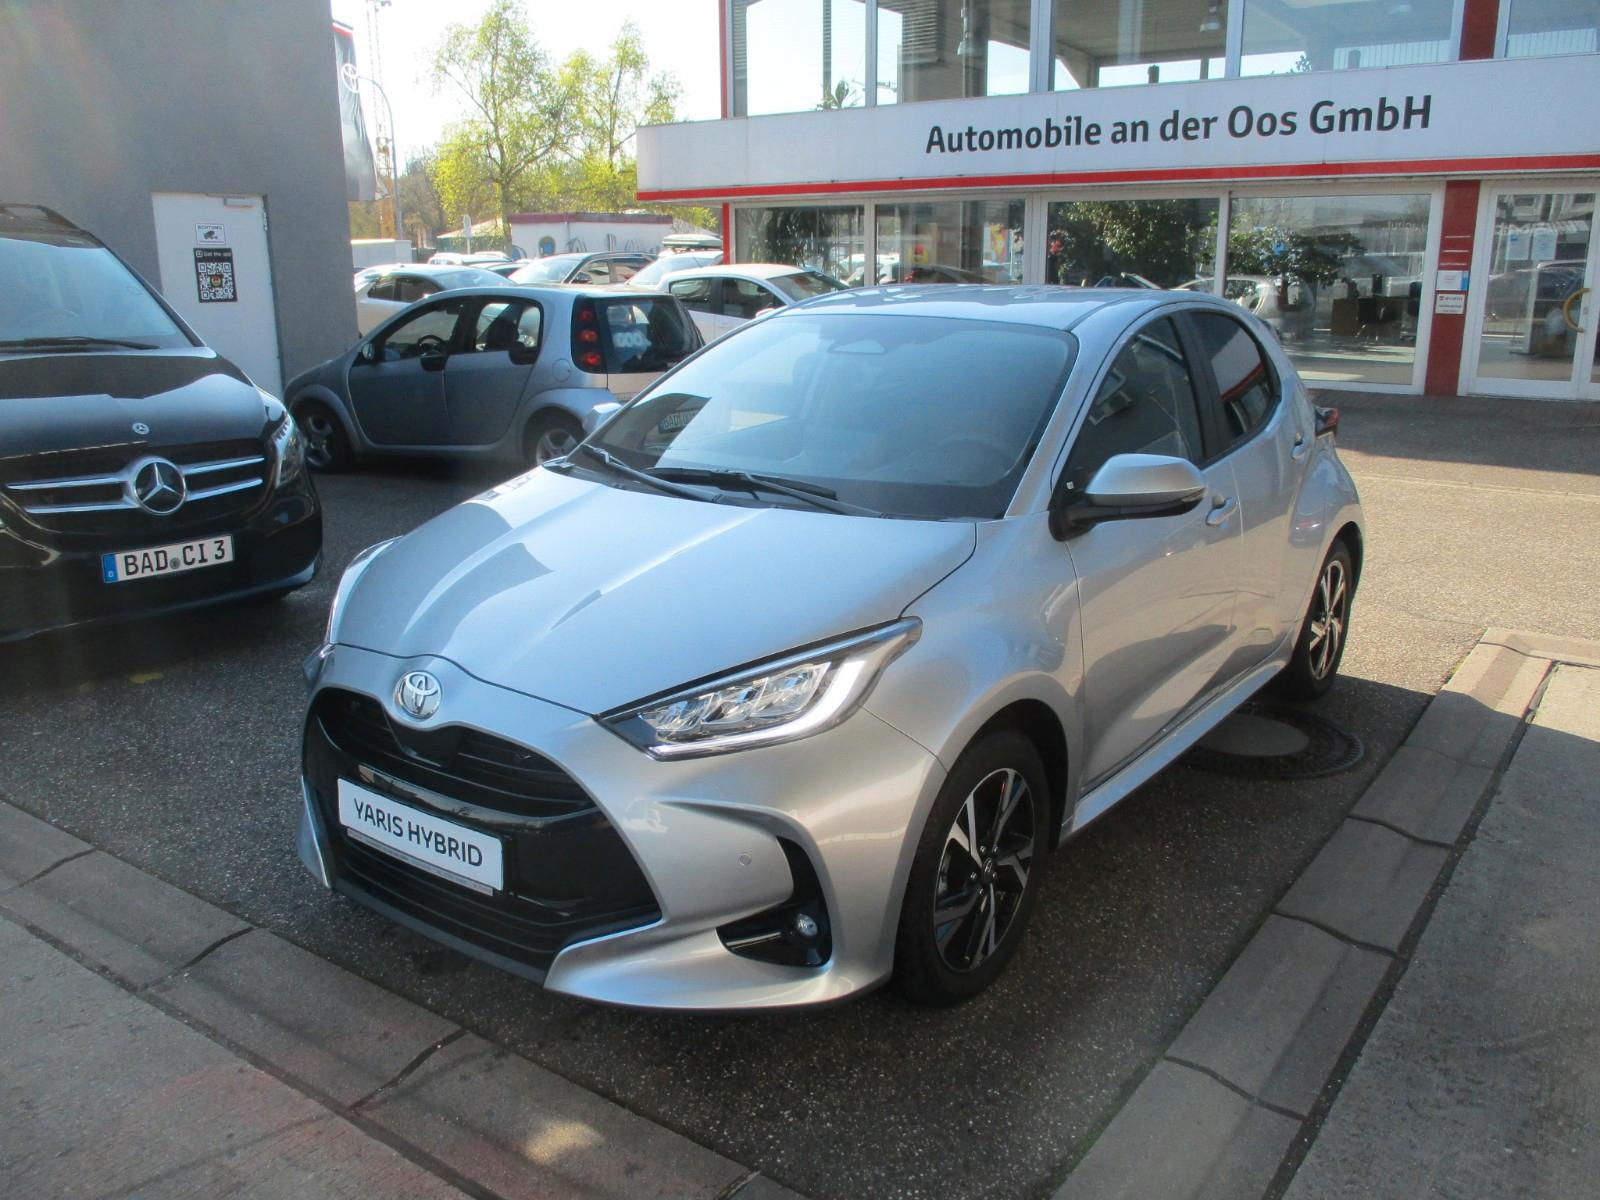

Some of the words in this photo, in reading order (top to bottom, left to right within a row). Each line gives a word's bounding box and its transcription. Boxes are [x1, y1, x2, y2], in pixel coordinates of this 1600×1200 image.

[926, 115, 1101, 153] Automobile
[1111, 119, 1149, 144] an
[1159, 109, 1218, 142] der
[1227, 105, 1297, 138] Oos
[1309, 94, 1432, 135] GmbH
[123, 549, 169, 576] BAD
[182, 543, 209, 566] CI
[214, 540, 225, 560] 3
[353, 798, 404, 838] YARIS
[407, 821, 483, 867] HYBRID
